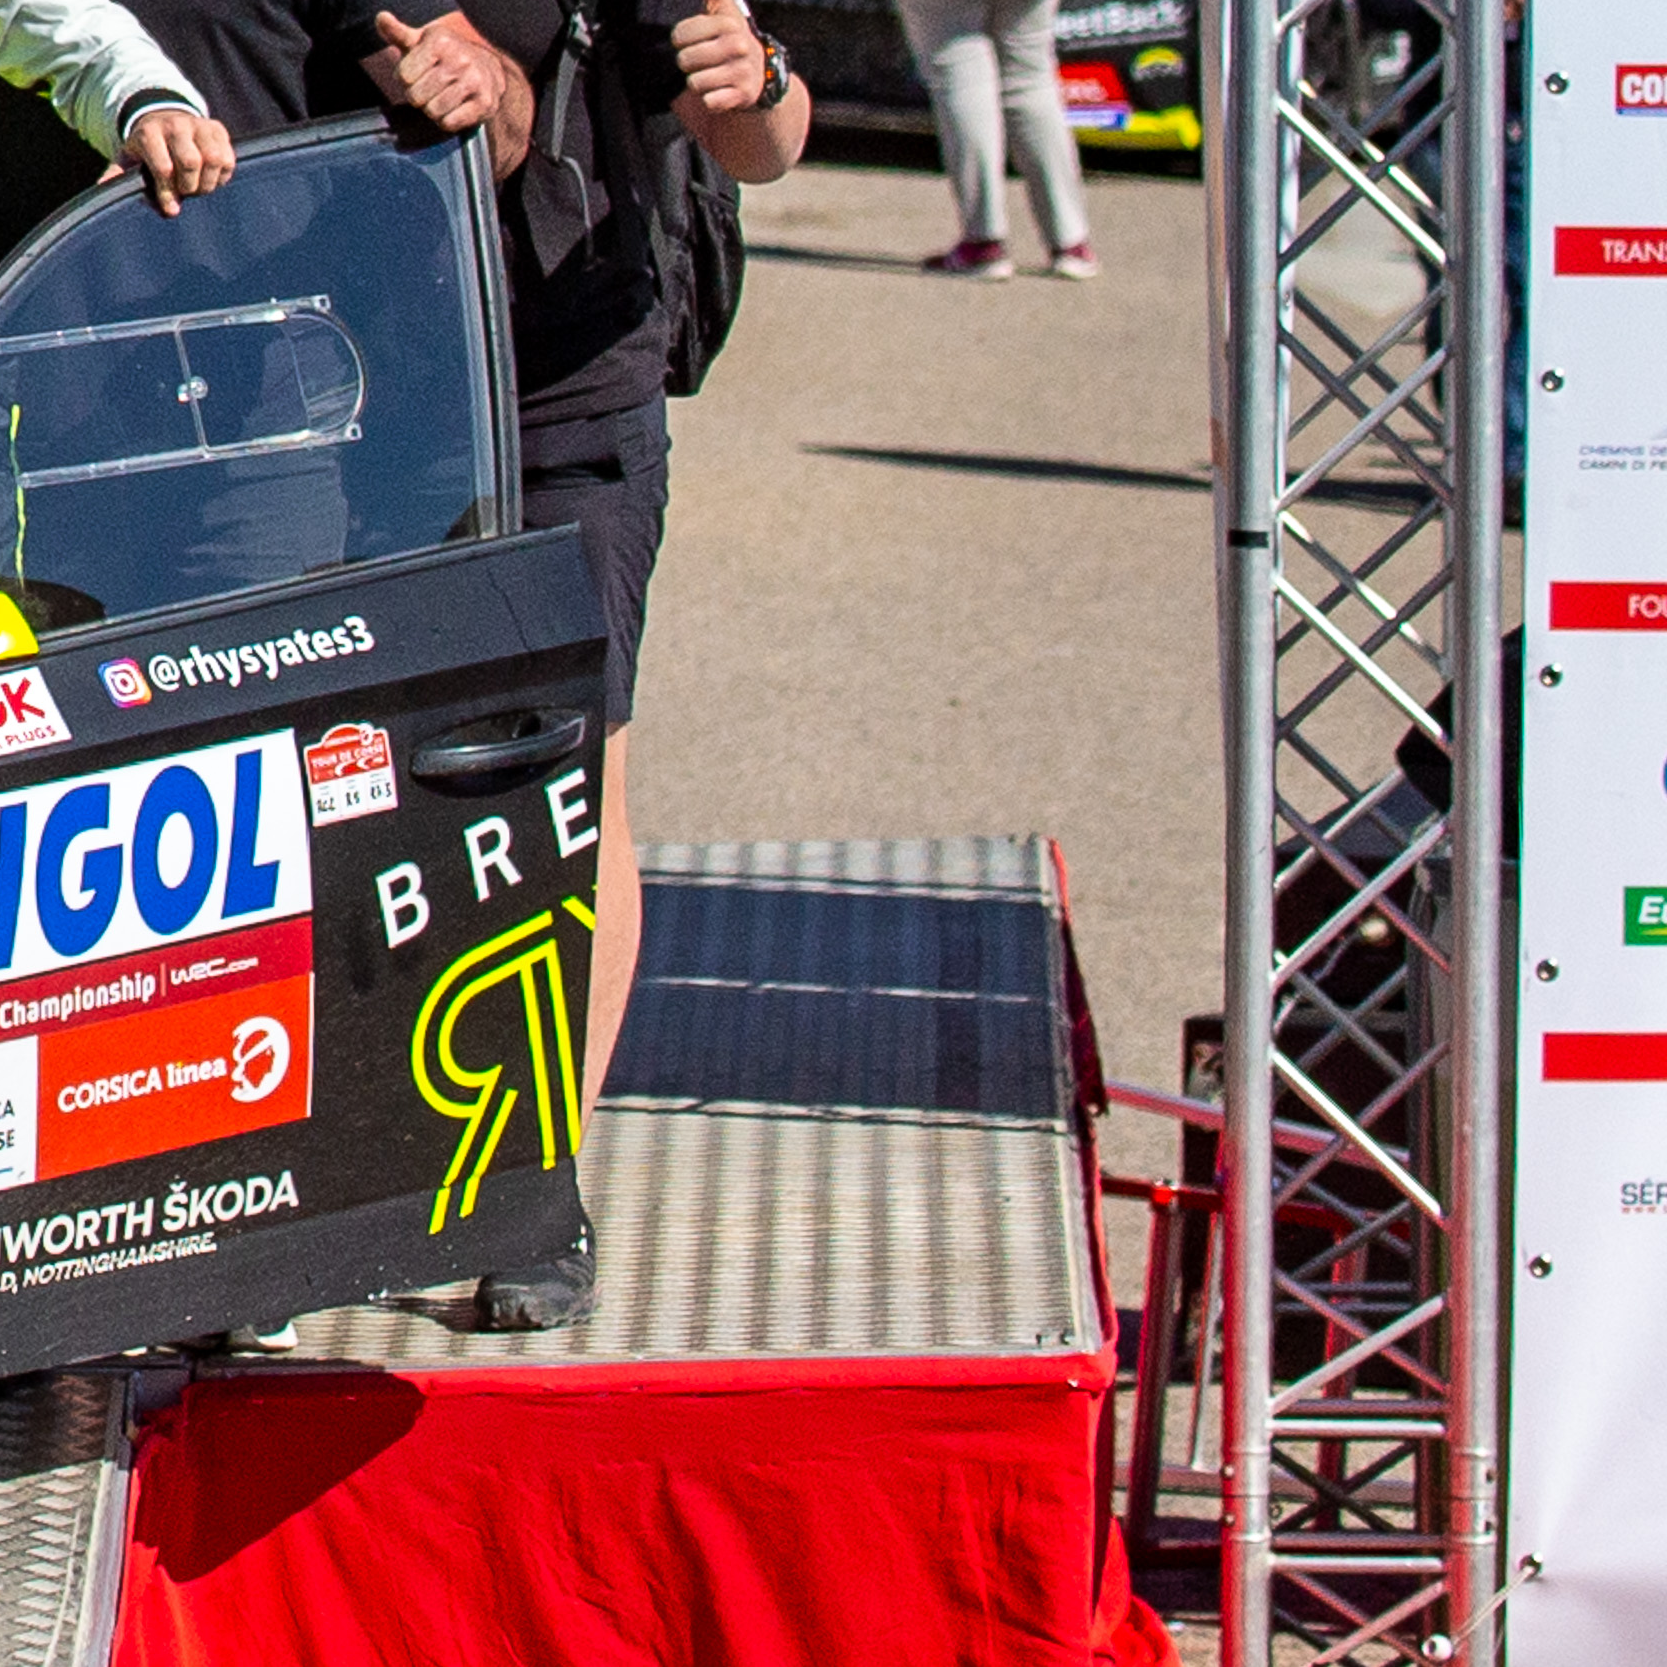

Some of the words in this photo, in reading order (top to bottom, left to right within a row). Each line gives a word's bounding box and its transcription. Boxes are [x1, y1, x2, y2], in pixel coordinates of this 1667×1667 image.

[1601, 237, 1667, 265] TRAN
[148, 615, 375, 692] @rhysyates3
[3, 725, 57, 749] PLUGS
[57, 1067, 163, 1113] CORSICA
[166, 1056, 228, 1091] linea
[162, 1169, 300, 1232] ŠKODA
